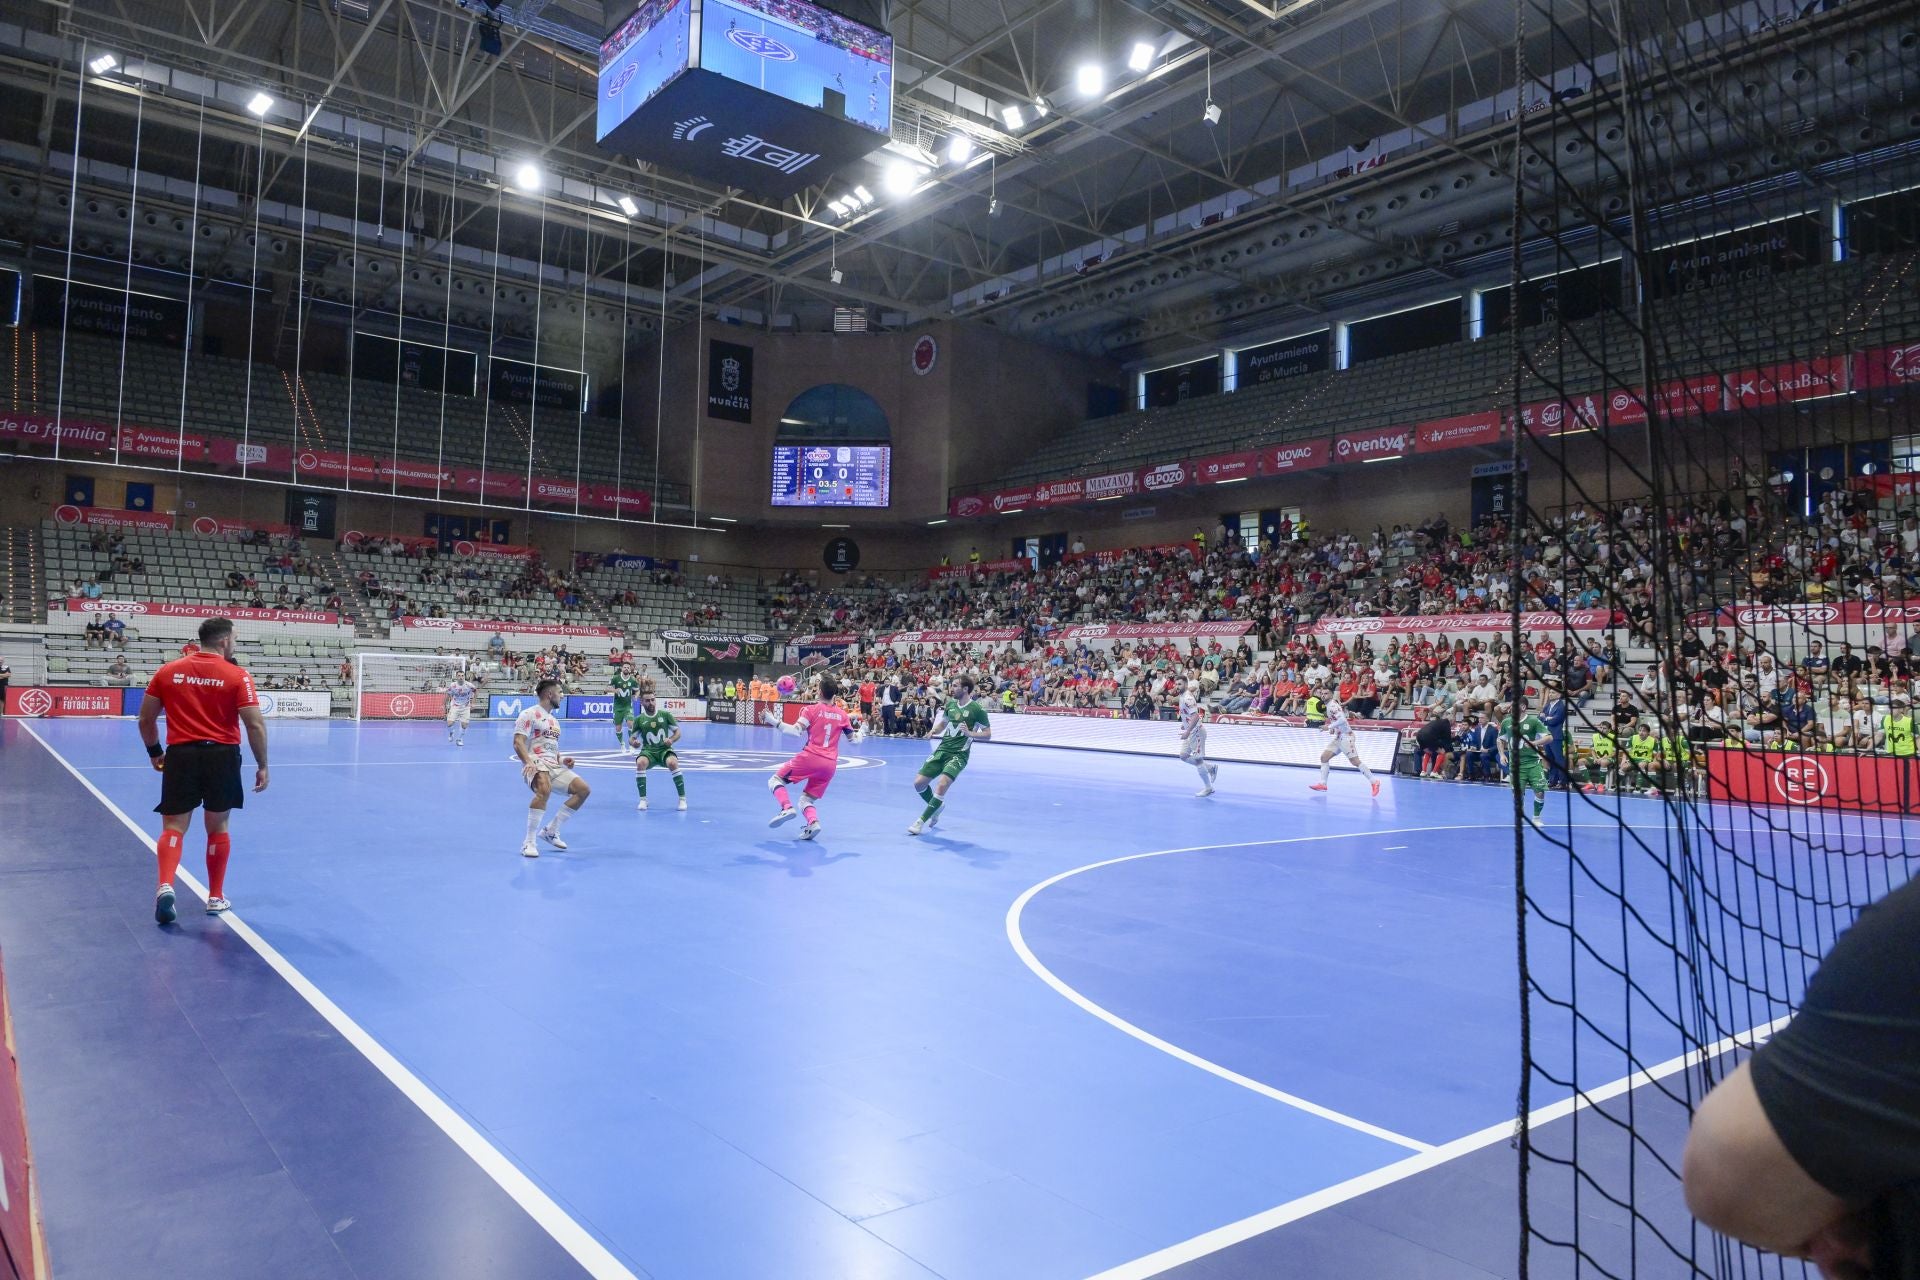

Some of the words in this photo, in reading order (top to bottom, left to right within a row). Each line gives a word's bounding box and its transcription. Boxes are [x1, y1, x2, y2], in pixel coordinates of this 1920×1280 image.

[1669, 237, 1790, 274] Ayunamiento
[1250, 344, 1319, 367] Ayuntamiento
[1273, 362, 1308, 378] Murcia
[710, 396, 750, 409] MURCIA
[23, 421, 39, 434] la
[42, 422, 106, 442] familia
[137, 432, 201, 448] Ayuntamiento
[1277, 447, 1312, 461] NOVAC
[814, 468, 823, 479] 0
[839, 468, 848, 479] 0
[1089, 473, 1130, 490] MANZANO
[1117, 487, 1133, 495] OLIVA
[135, 521, 169, 529] MURCIA
[615, 559, 645, 568] CORNY
[161, 604, 196, 614] Uno
[201, 605, 231, 616] más
[237, 607, 254, 617] de
[258, 609, 271, 618] la
[274, 610, 326, 622] familia
[1117, 625, 1142, 635] Uno
[1195, 620, 1240, 634] familia
[1398, 617, 1435, 629] Uno
[1438, 617, 1472, 627] más
[1476, 615, 1498, 626] de
[694, 635, 741, 643] COMPARTIR
[671, 645, 695, 655] LEGADO
[91, 701, 110, 710] SALA
[667, 701, 686, 709] STM
[823, 723, 832, 747] 1
